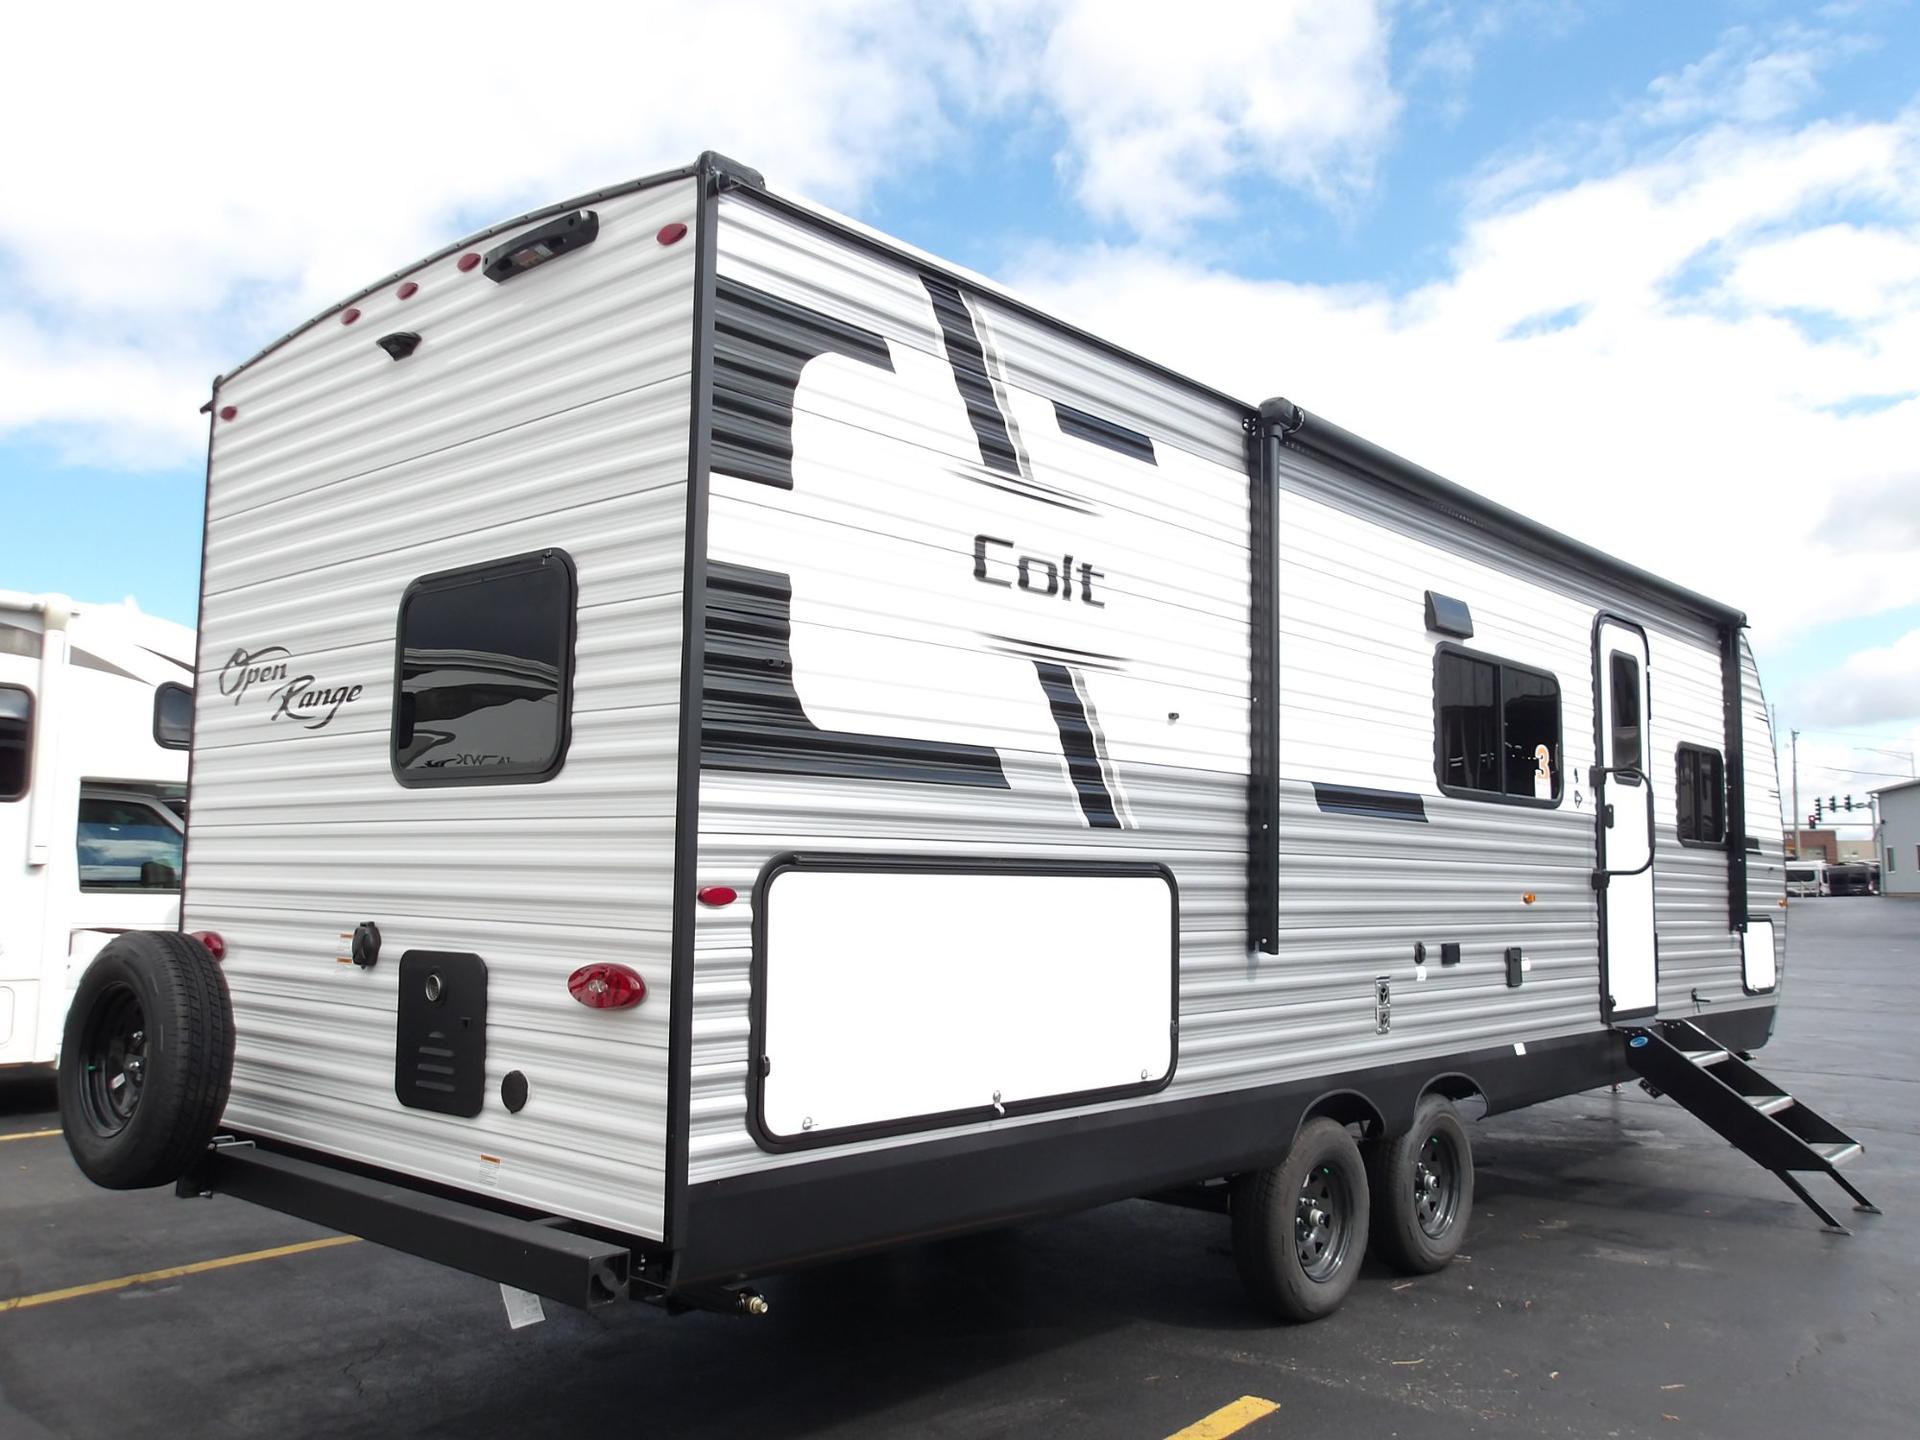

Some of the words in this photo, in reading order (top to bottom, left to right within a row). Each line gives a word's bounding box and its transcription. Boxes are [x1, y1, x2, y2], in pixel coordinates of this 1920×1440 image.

[973, 534, 1105, 609] Colt
[219, 646, 292, 706] Open
[267, 674, 364, 730] Range
